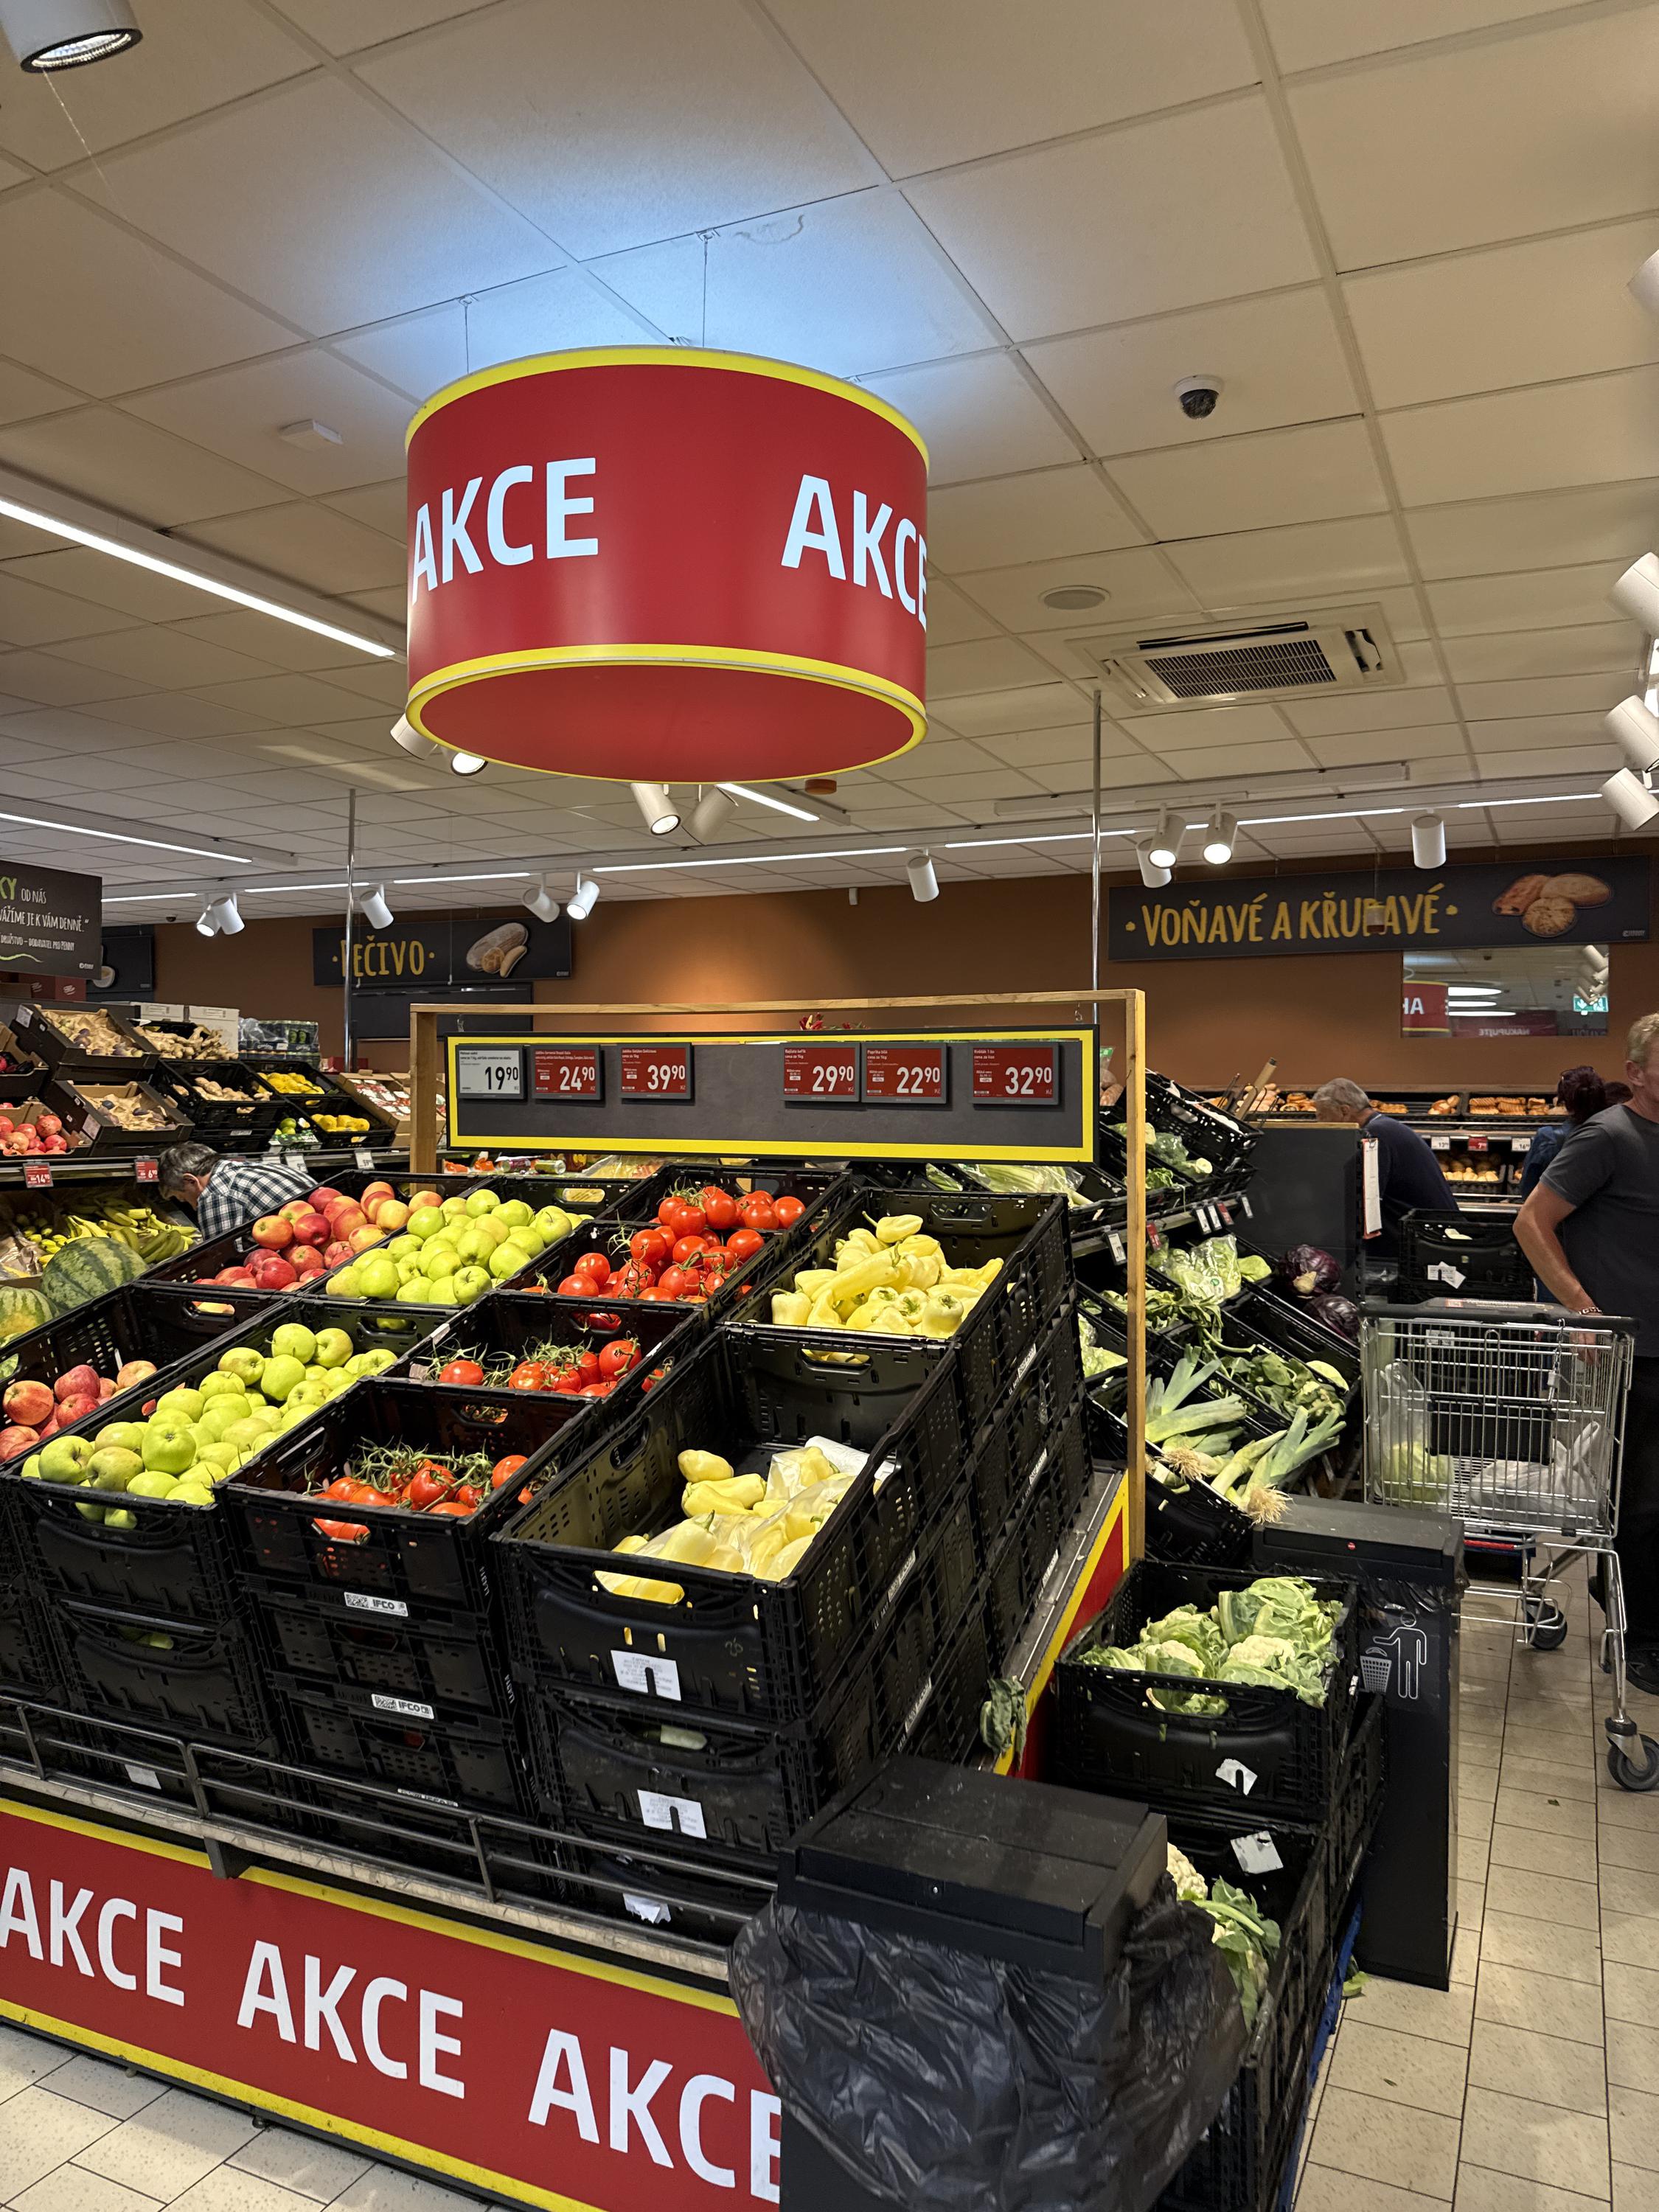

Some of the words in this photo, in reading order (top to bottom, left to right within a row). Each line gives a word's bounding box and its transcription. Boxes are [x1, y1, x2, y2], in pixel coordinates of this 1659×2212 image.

[412, 457, 598, 606] AKCE
[781, 474, 927, 633] AKCE
[21, 888, 31, 902] OD
[32, 888, 46, 904] NÁS
[27, 912, 35, 927] JE
[35, 913, 41, 927] K
[42, 912, 58, 929] VÁM
[1142, 892, 1267, 946] VOŇAVÉ
[1270, 901, 1293, 939] A
[372, 1599, 395, 1610] IFCO
[398, 1700, 420, 1713] IFCO
[0, 1867, 185, 2007] AKCE
[236, 1940, 465, 2099] AKCE
[528, 2028, 781, 2205] AKCE
